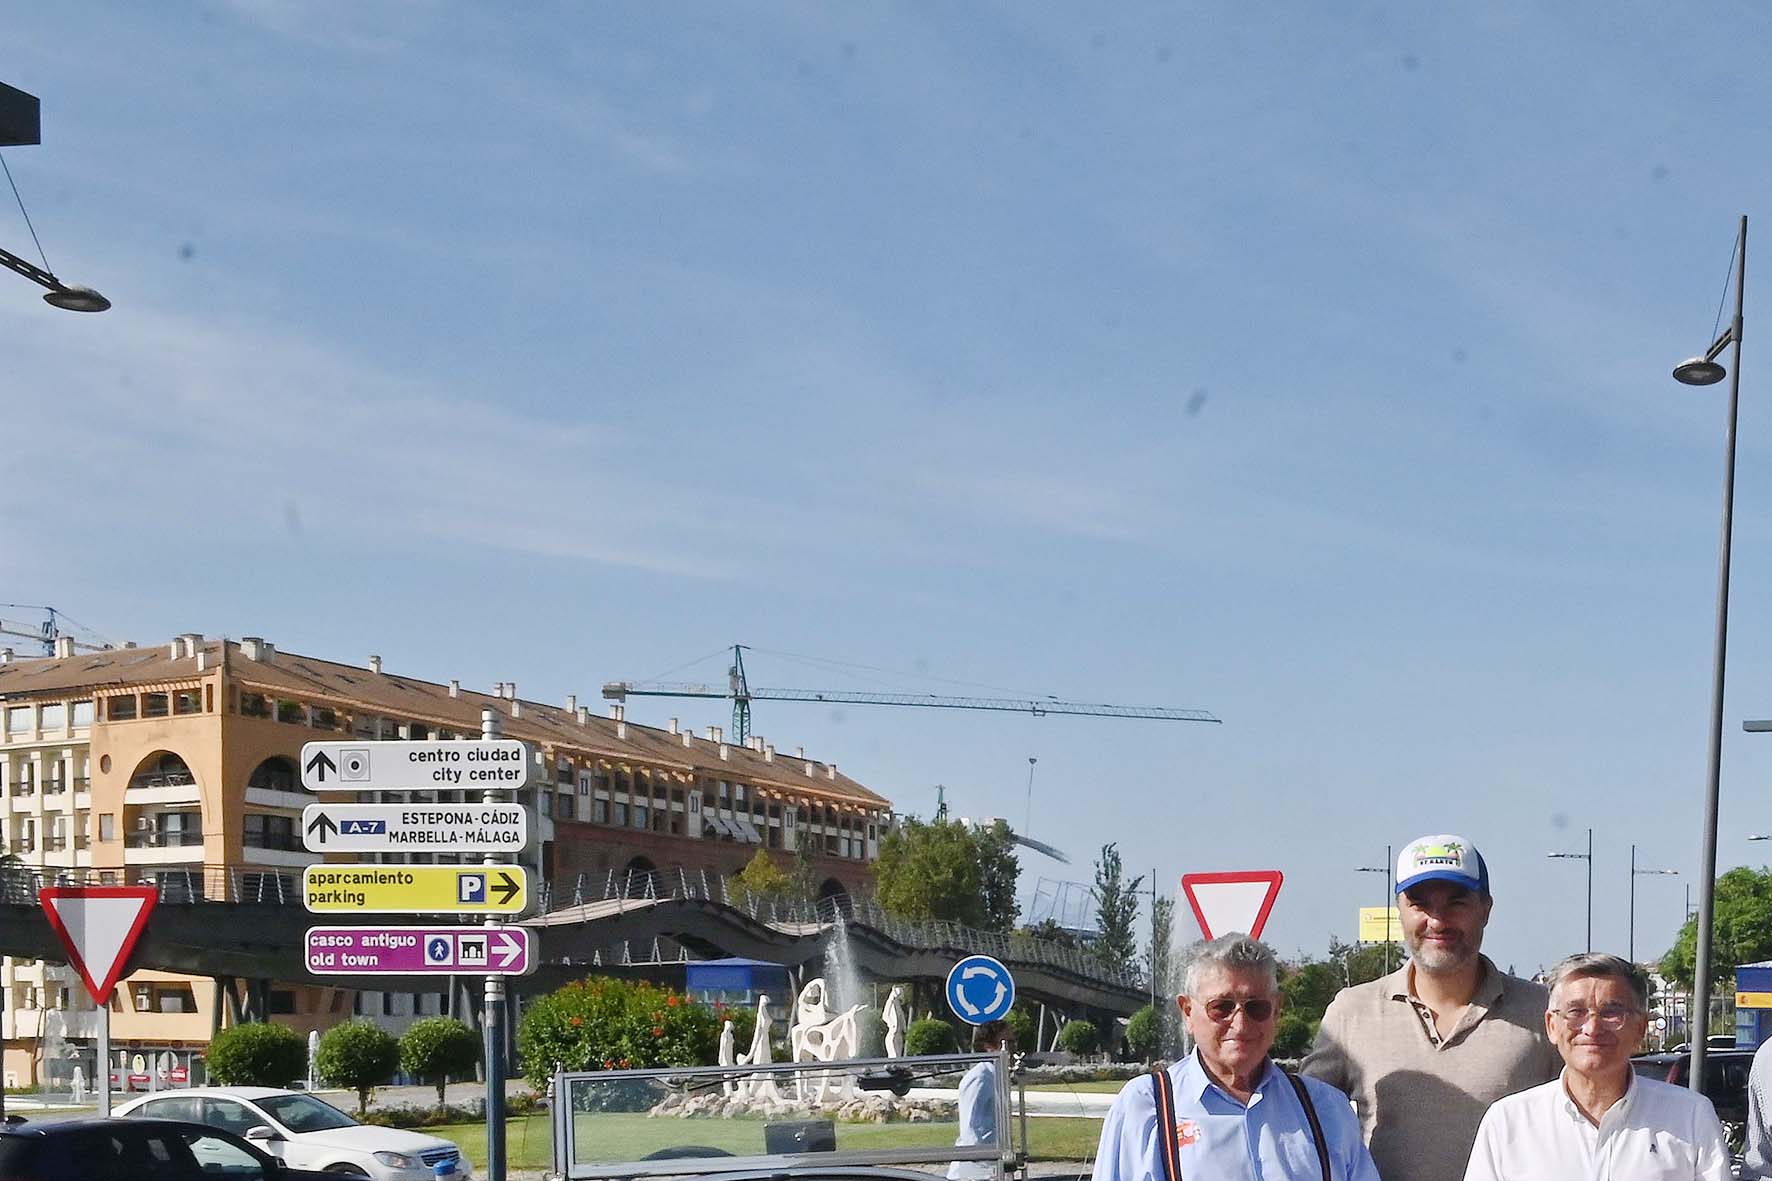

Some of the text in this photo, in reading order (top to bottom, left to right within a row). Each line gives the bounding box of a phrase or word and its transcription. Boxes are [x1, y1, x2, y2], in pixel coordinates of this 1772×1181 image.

[409, 748, 521, 762] centro ciudad
[433, 767, 521, 783] city center
[349, 822, 377, 833] A-7
[308, 871, 414, 886] aparcamiento
[461, 876, 482, 900] P
[308, 891, 365, 905] parking
[310, 933, 417, 950] casco antiguo
[310, 952, 379, 966] old town
